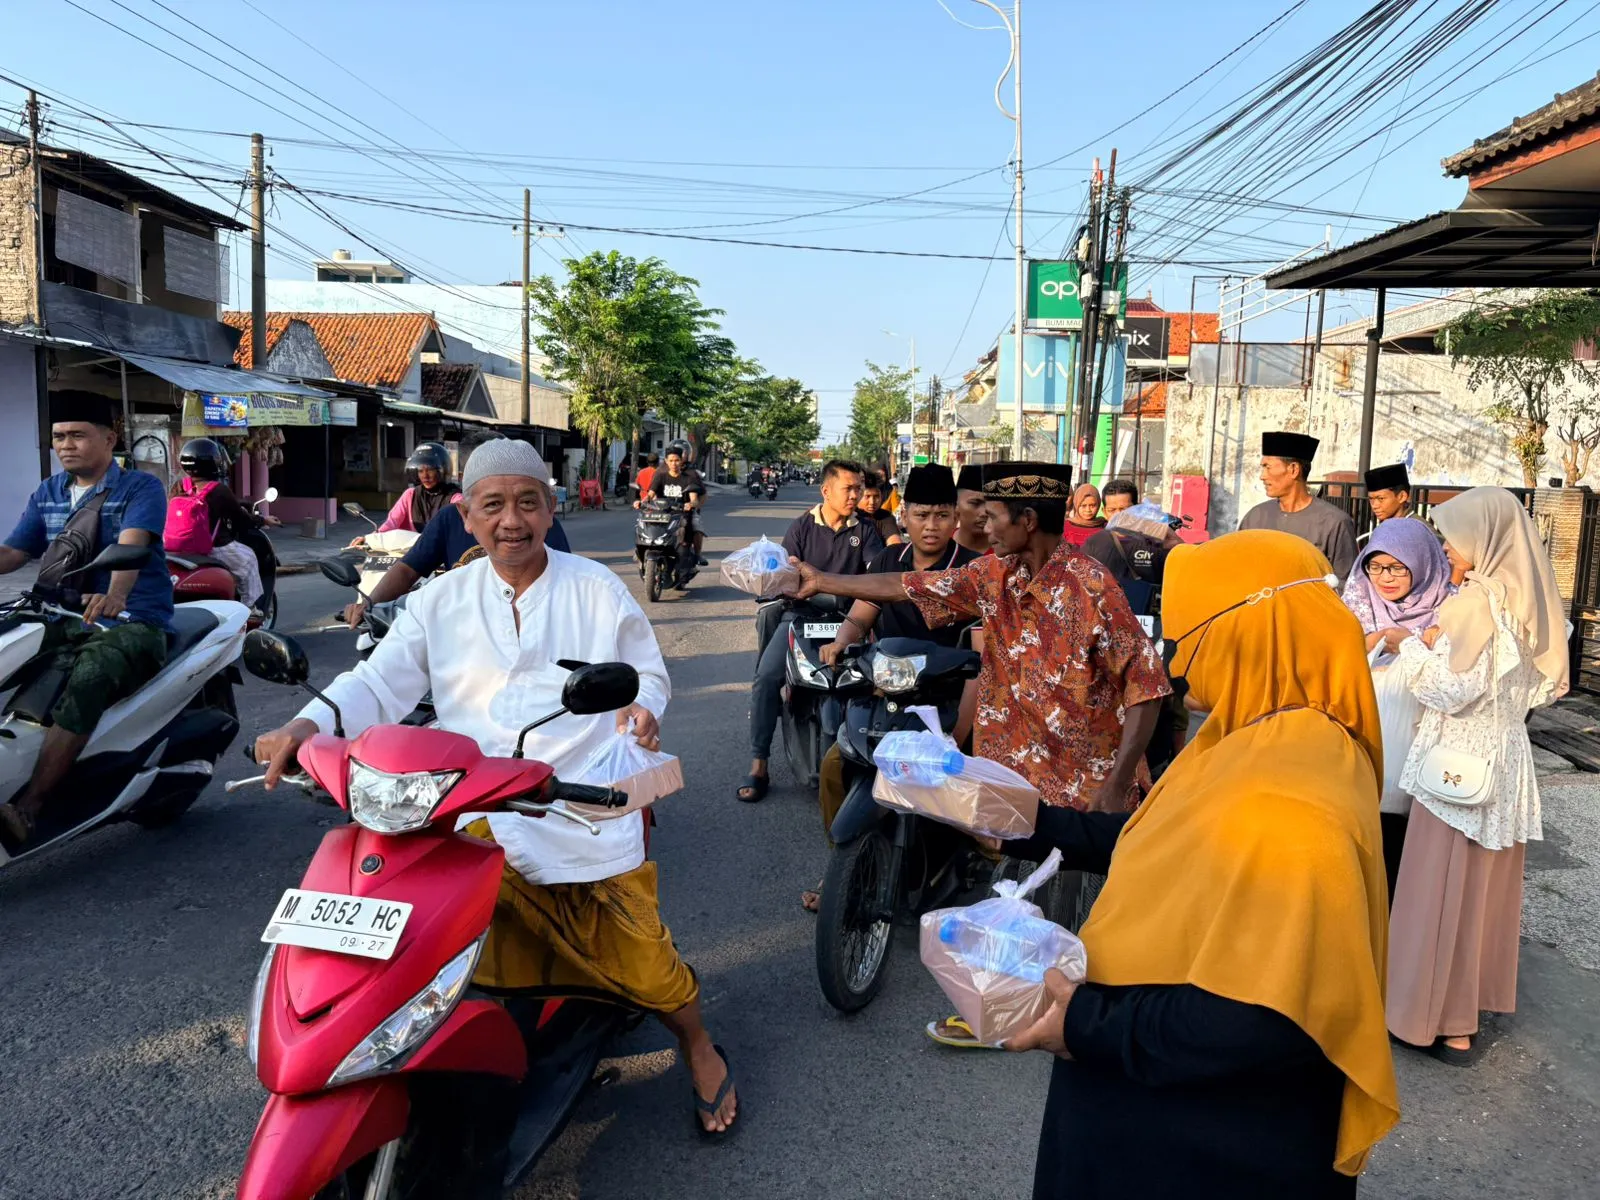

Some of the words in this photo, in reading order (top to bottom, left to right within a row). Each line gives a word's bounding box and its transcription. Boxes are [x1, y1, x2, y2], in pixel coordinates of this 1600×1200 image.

[818, 624, 841, 632] 3690
[280, 896, 302, 919] M
[310, 898, 362, 926] 5052
[370, 905, 402, 932] HC
